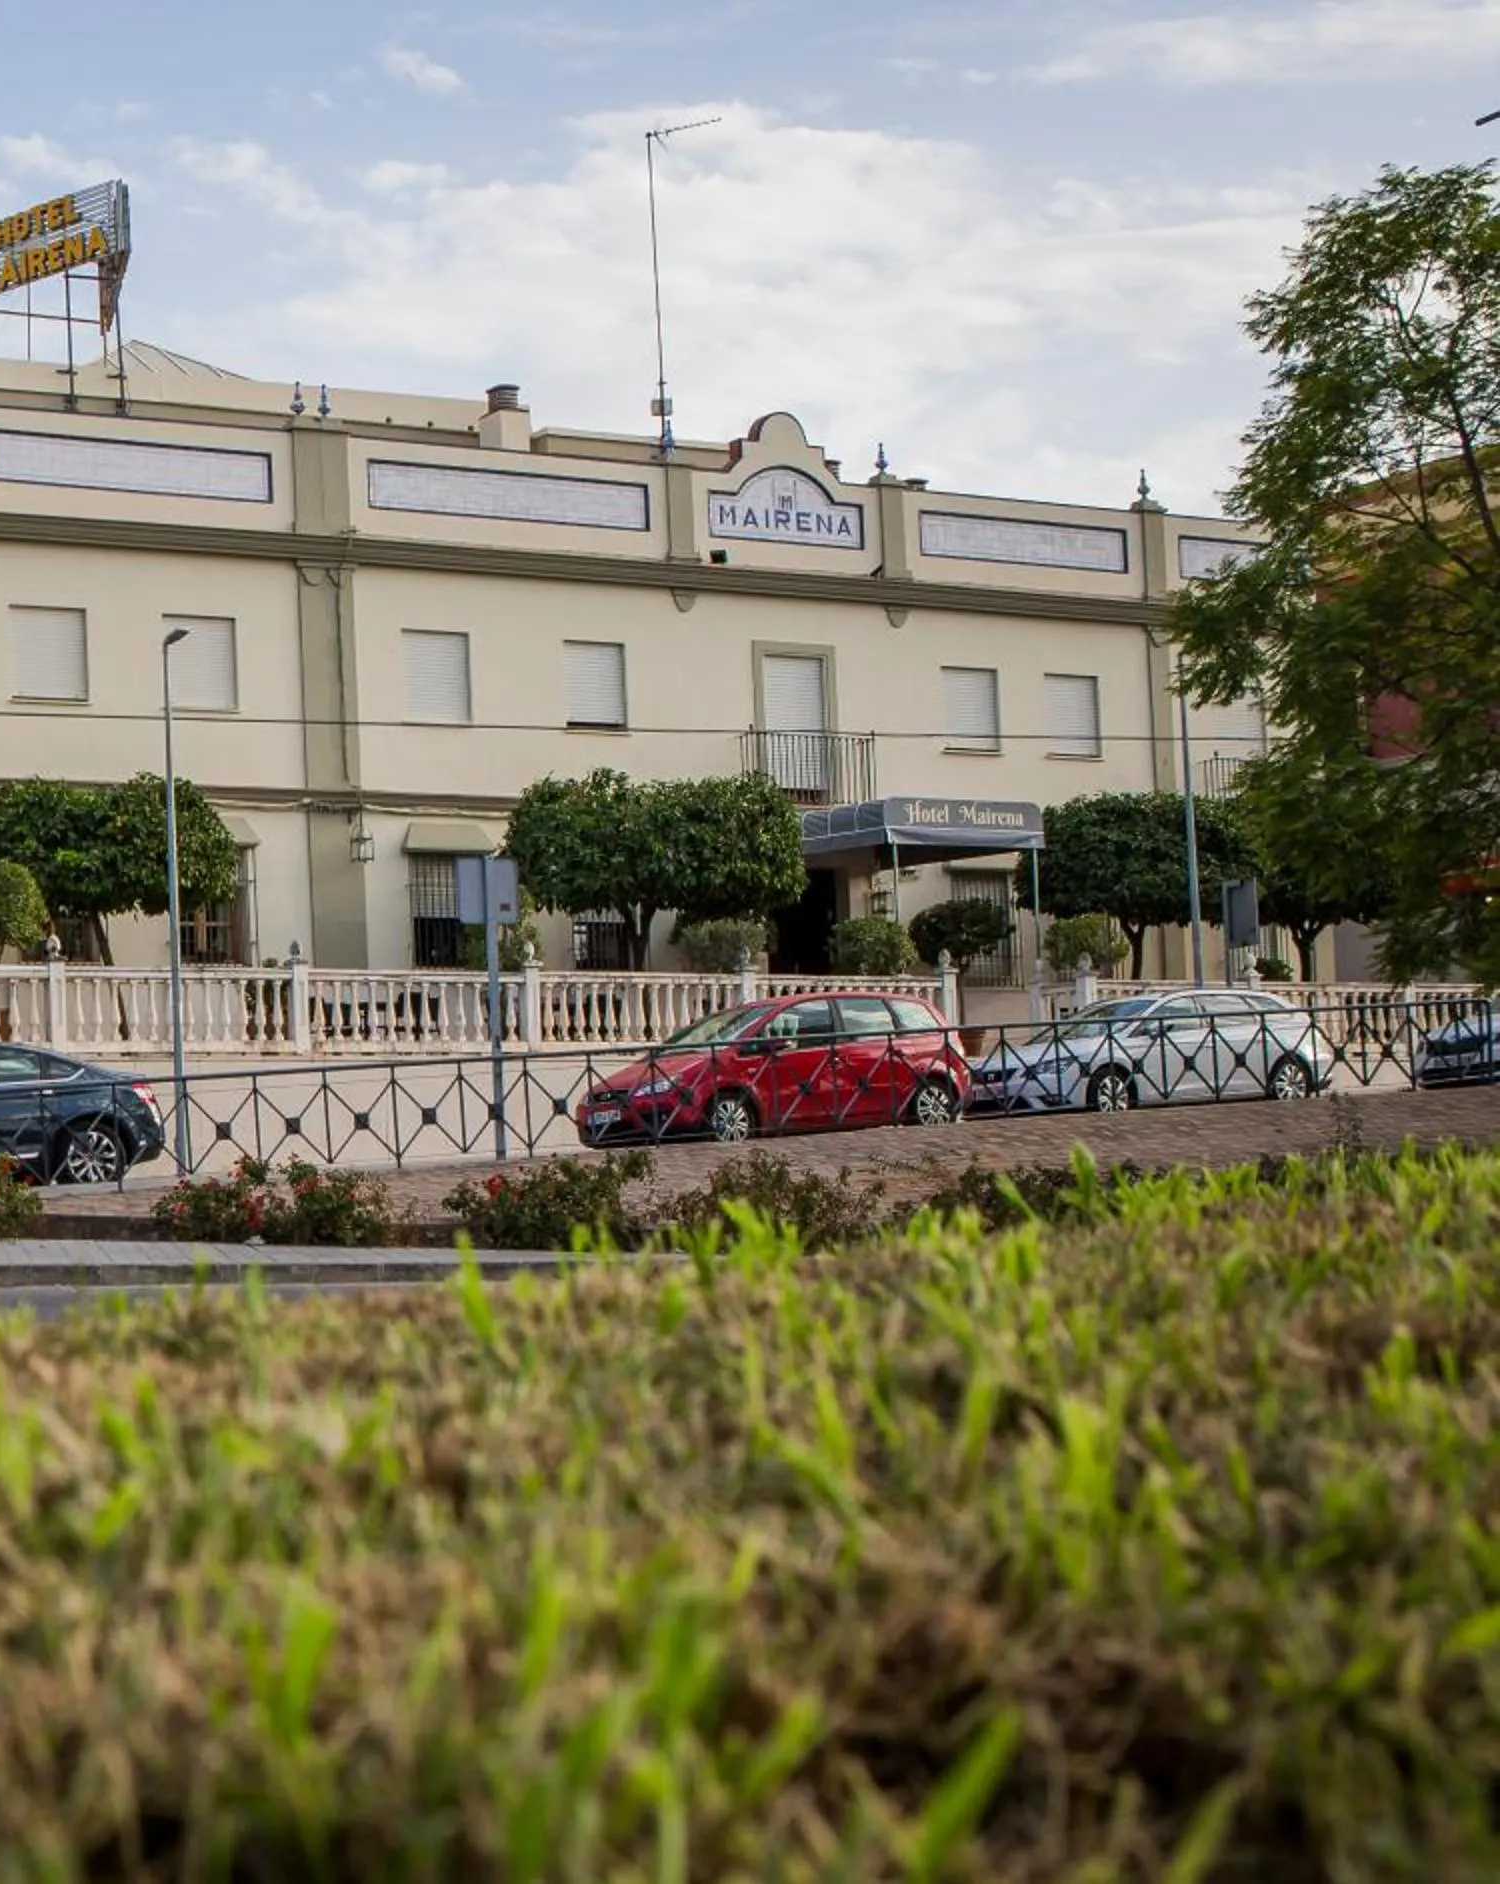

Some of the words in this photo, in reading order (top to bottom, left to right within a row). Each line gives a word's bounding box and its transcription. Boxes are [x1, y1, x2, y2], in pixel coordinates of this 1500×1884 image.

[718, 504, 852, 537] MAIRENA
[904, 800, 949, 825] Hotel
[958, 801, 1025, 827] Mairena
